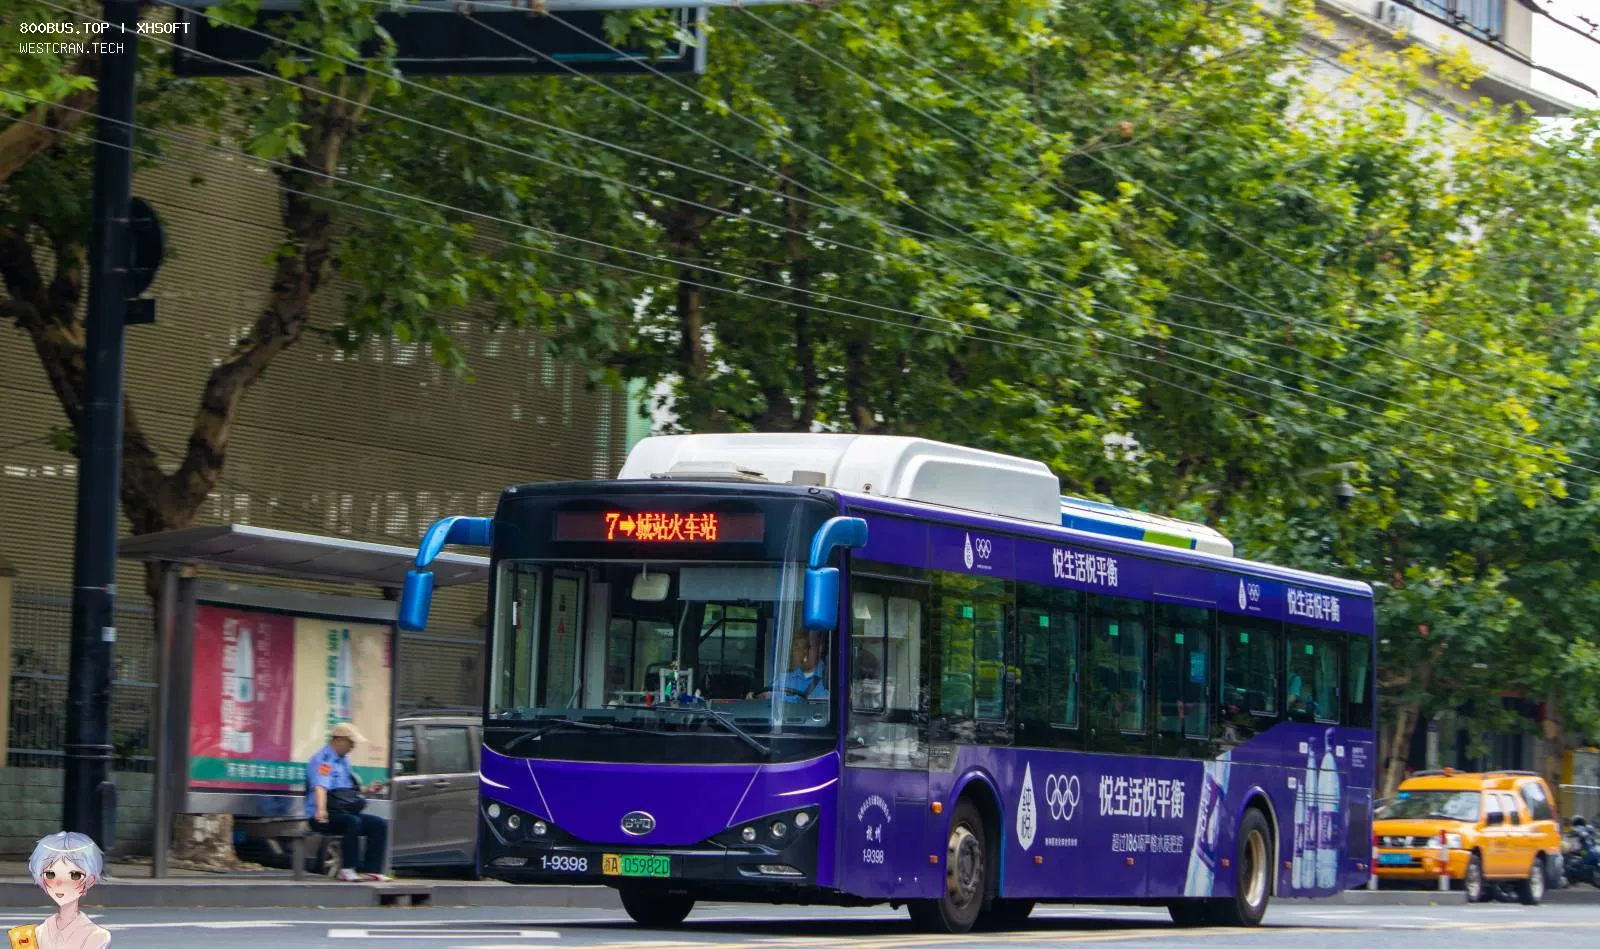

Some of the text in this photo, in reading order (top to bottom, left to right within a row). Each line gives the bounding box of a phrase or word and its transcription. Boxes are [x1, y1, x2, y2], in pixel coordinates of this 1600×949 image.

[605, 513, 718, 540] 7 城站火车站
[1052, 547, 1119, 587] 悦生活悦平衡
[1287, 587, 1341, 623] 悦生活悦平衡
[1099, 775, 1185, 819] 悦生活悦平衡
[540, 855, 589, 872] 1-9398
[862, 848, 885, 865] 1-9398
